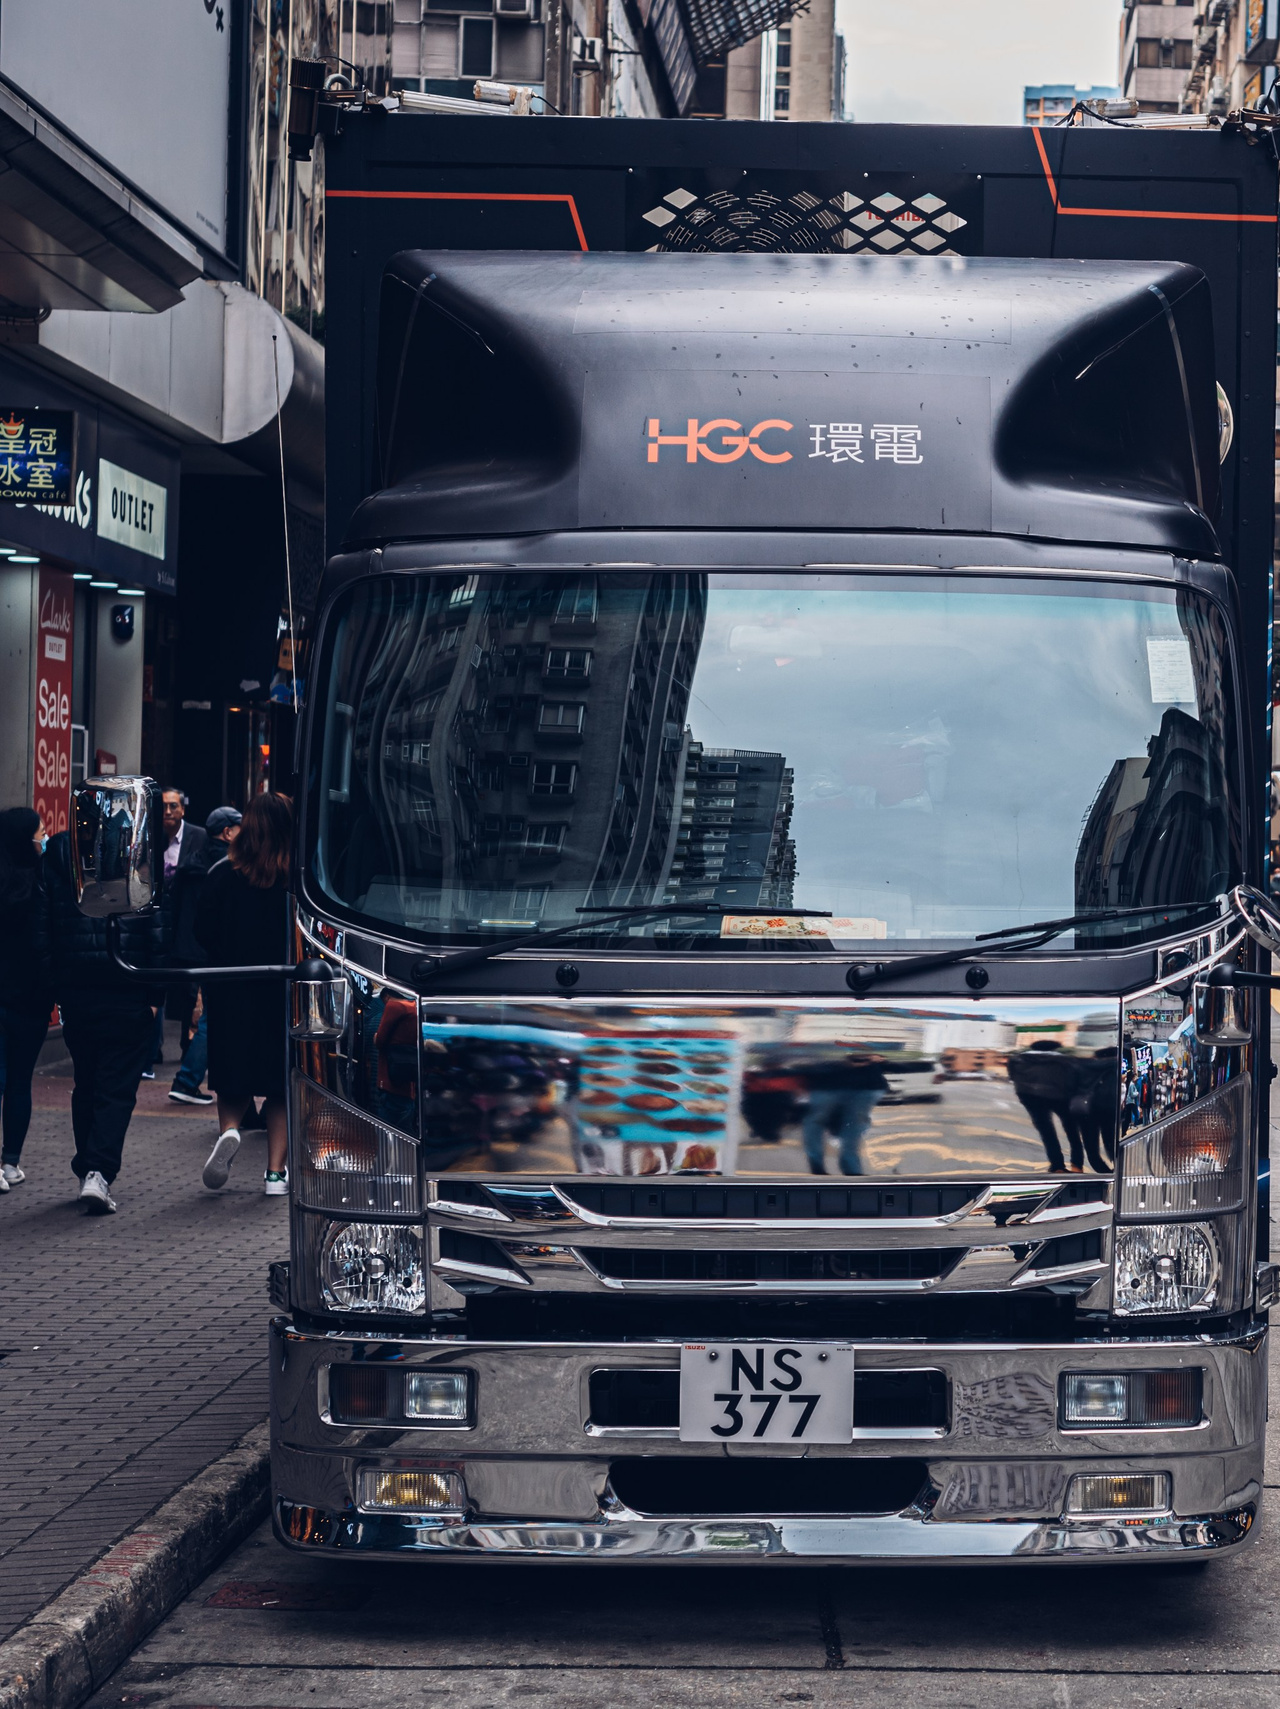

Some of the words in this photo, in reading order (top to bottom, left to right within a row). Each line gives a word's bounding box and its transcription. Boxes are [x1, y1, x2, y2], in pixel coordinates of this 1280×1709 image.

[646, 417, 794, 465] HGC
[808, 421, 924, 466] 環電
[42, 490, 67, 500] café
[111, 486, 155, 535] OUTLET
[40, 588, 71, 634] Clarks
[48, 642, 63, 654] OUTLET
[38, 677, 69, 731] Sale
[37, 737, 68, 789] Sale
[731, 1348, 803, 1392] NS
[710, 1393, 822, 1438] 377
